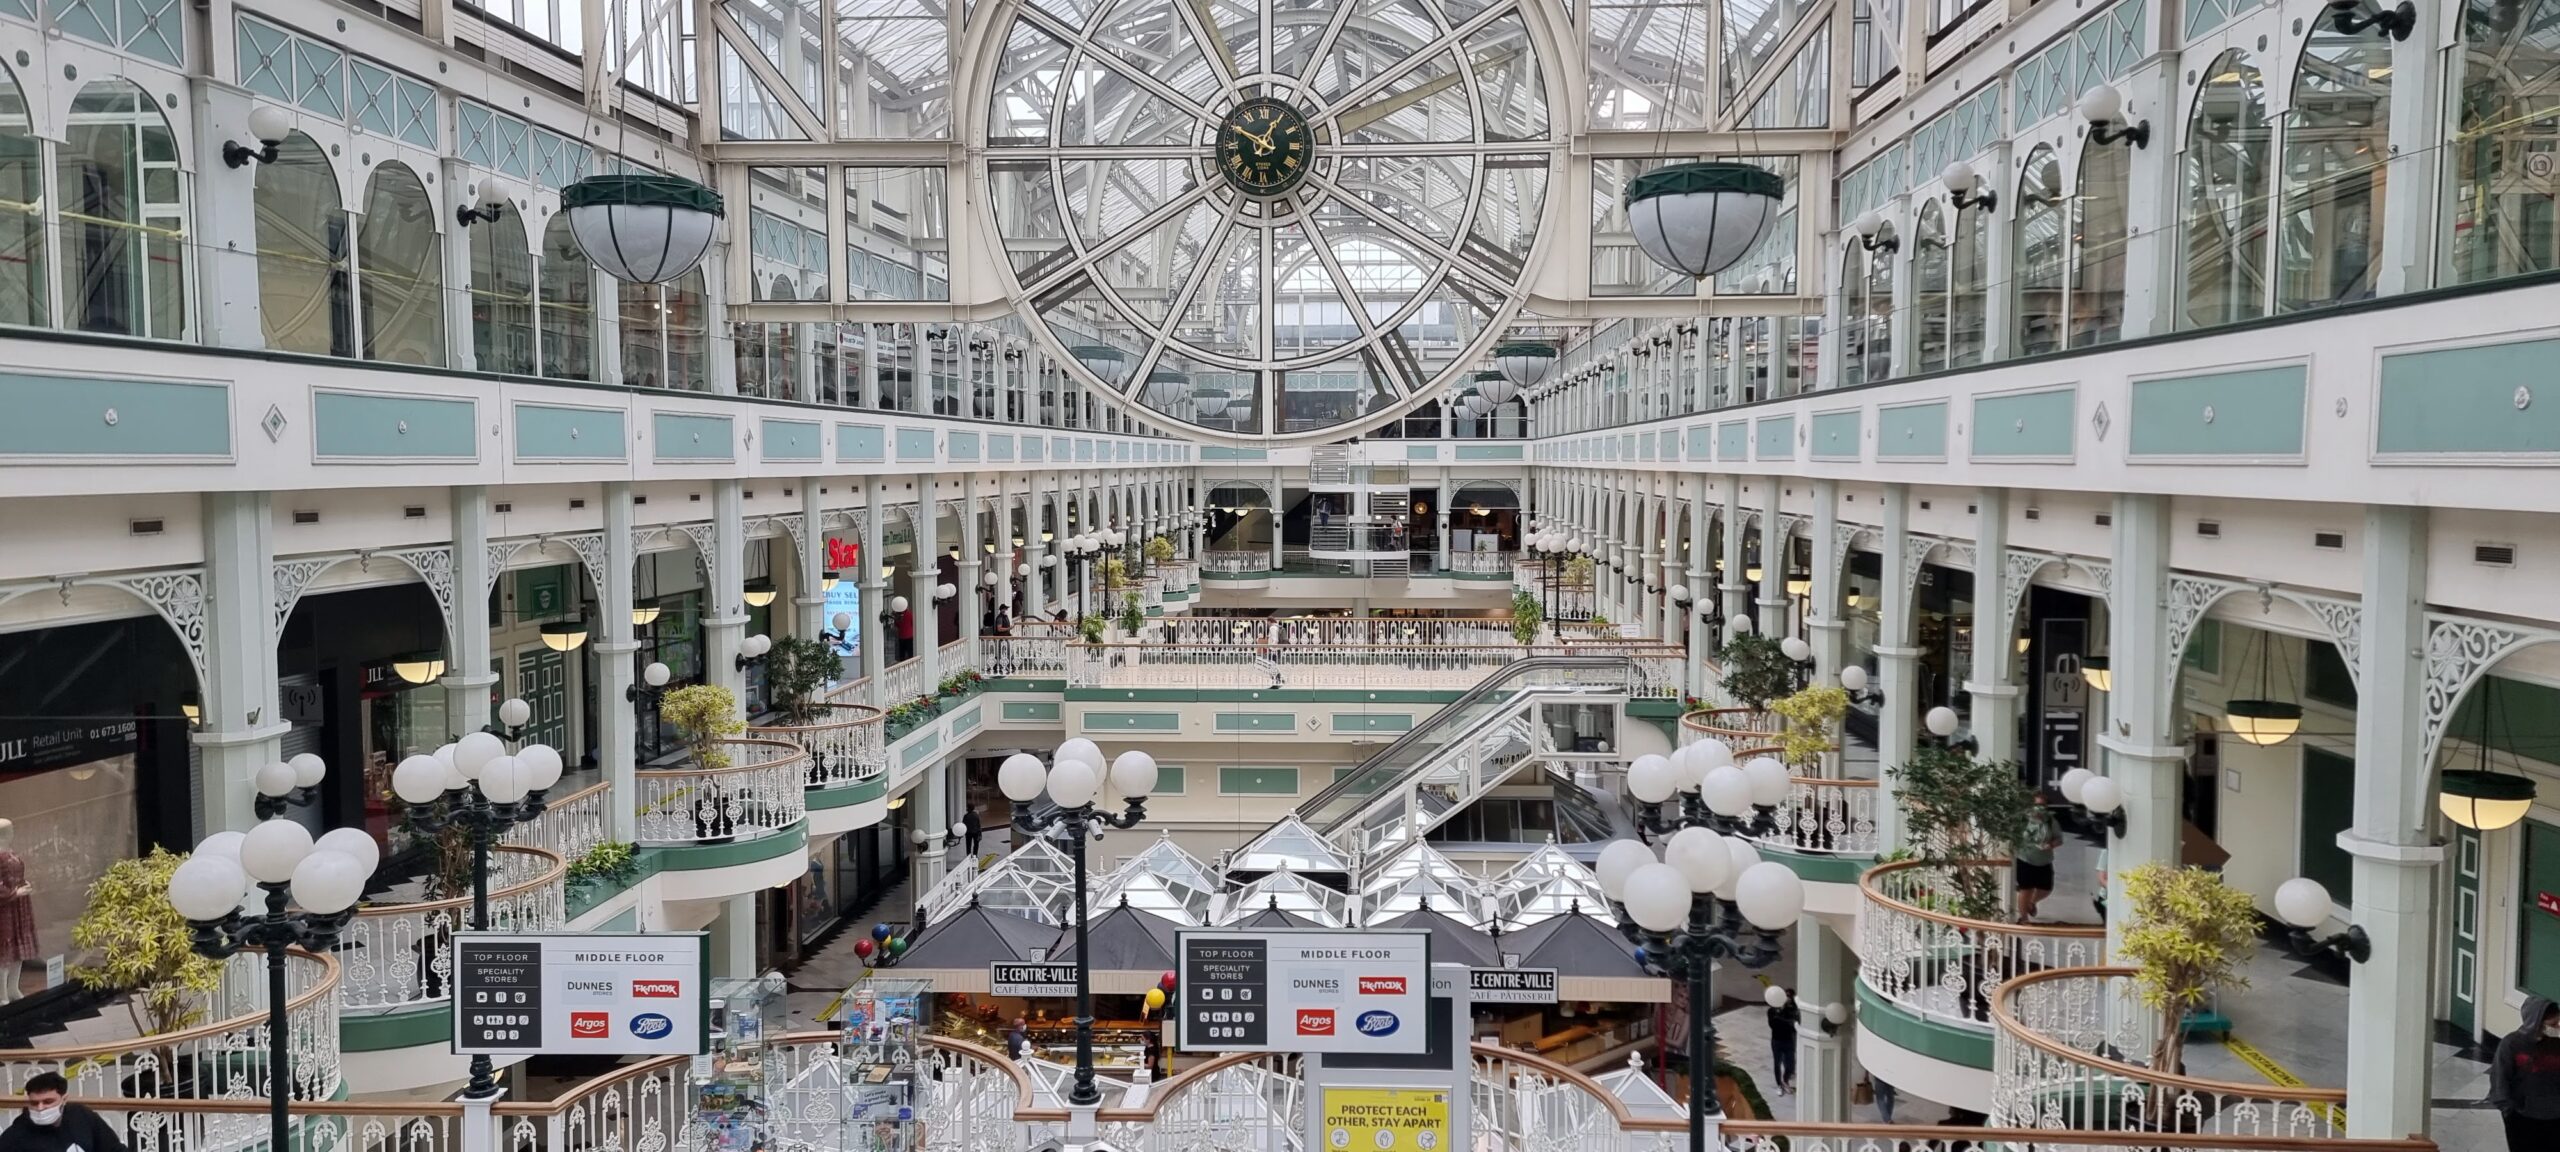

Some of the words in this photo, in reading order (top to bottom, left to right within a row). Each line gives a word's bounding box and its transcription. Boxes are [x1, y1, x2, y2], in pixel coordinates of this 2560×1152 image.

[33, 732, 60, 748] Retail
[63, 728, 83, 743] Unit
[90, 729, 100, 739] 01
[101, 725, 116, 737] 673
[474, 954, 492, 962] TOP
[496, 954, 529, 962] FLOOR
[575, 953, 620, 962] MIDDLE
[625, 953, 664, 962] FLOOR
[1200, 950, 1219, 958] TOP
[1222, 950, 1254, 958] FLOOR
[1301, 950, 1347, 959] MIDDLE
[1351, 950, 1391, 959] FLOOR
[996, 967, 1007, 982] LE
[1009, 967, 1077, 982] CENTRE-VILLE
[1482, 973, 1552, 988] CENTRE-VILLE
[567, 981, 613, 991] DUNNES
[995, 985, 1019, 994] CAFÉ
[1293, 980, 1339, 989] DUNNES
[1432, 978, 1452, 990] ion
[574, 1017, 606, 1030] Argos
[634, 1018, 667, 1034] Boots
[1300, 1014, 1331, 1027] Argos
[1360, 1015, 1394, 1032] Boots
[1341, 1105, 1393, 1116] PROTECT
[1396, 1106, 1427, 1116] EACH
[1327, 1116, 1369, 1128] OTHER,
[1371, 1117, 1401, 1128] STAY
[1402, 1118, 1442, 1128] APART
